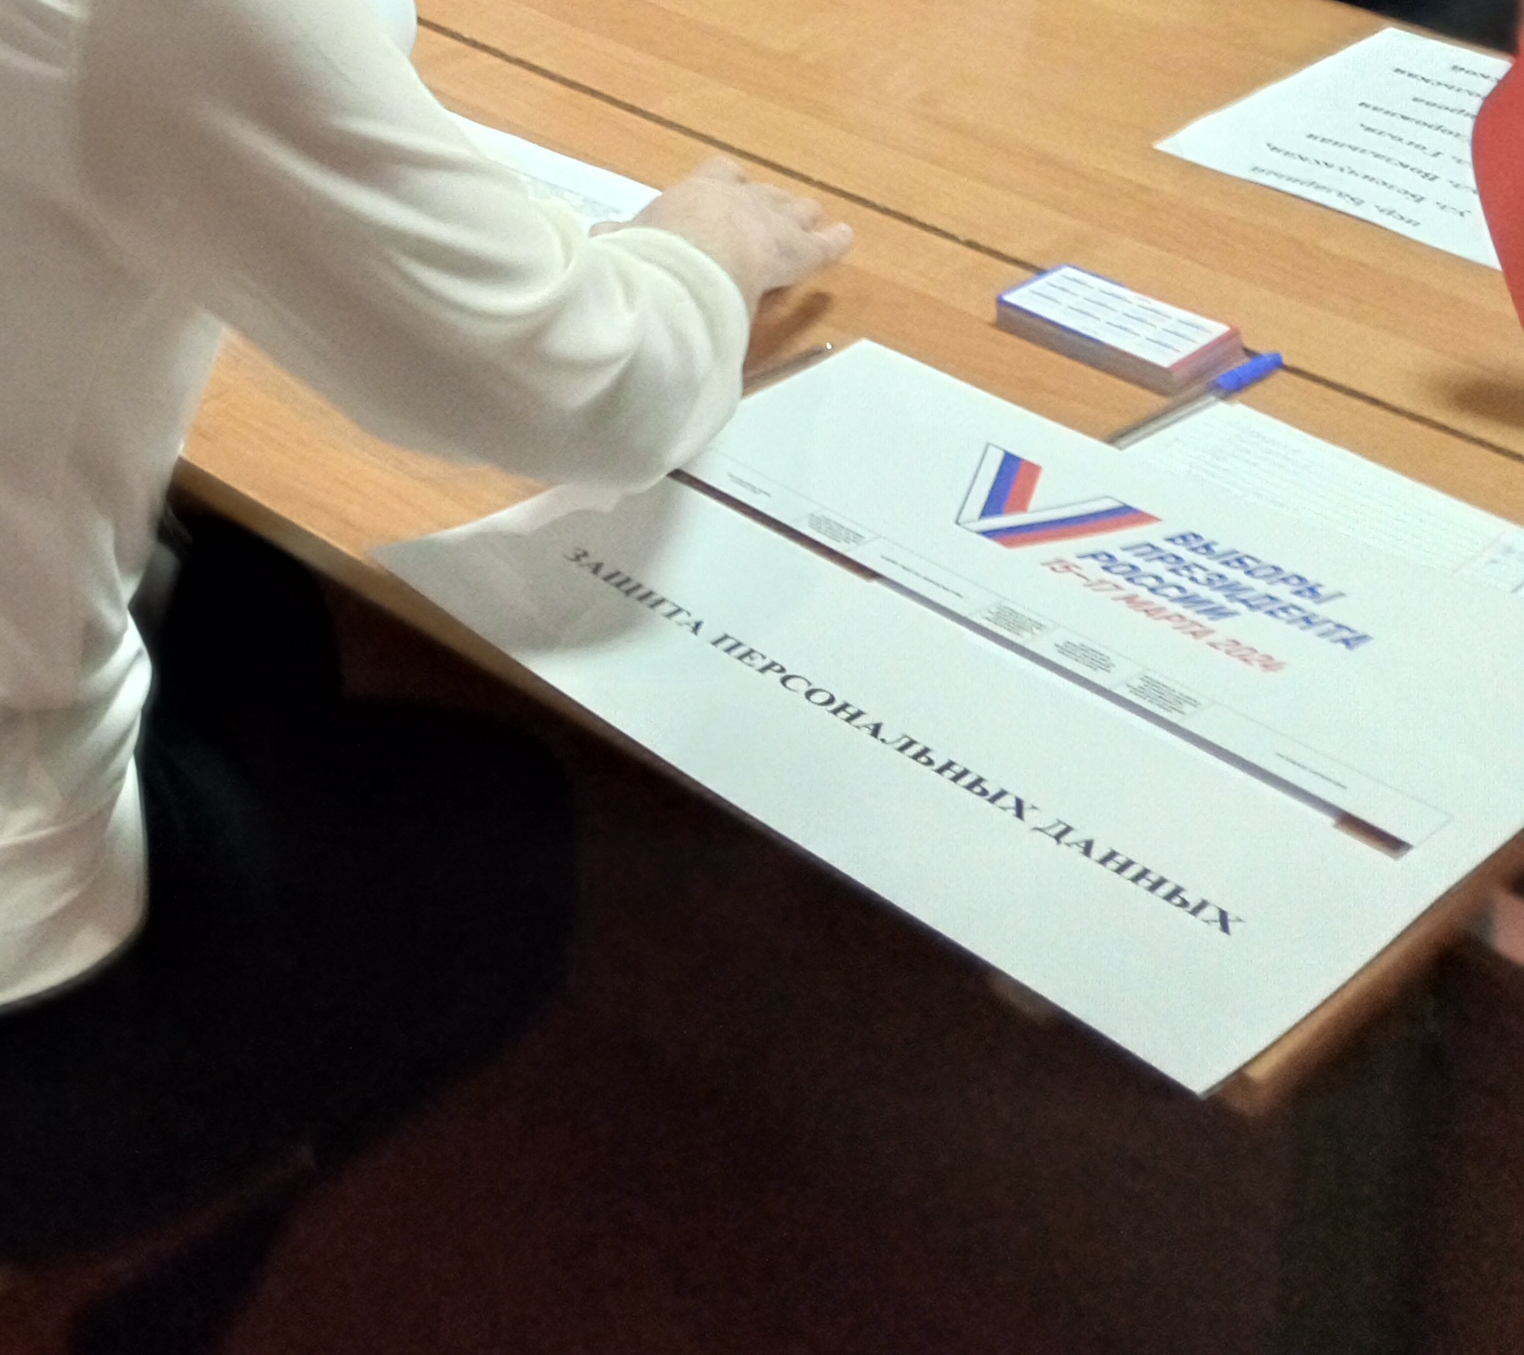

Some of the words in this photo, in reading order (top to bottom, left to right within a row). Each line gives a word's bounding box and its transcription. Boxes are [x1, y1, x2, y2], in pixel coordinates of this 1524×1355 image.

[1076, 550, 1242, 622] РОССИИ
[1119, 541, 1374, 651] ПРЕЗИДЕНТА
[1162, 530, 1347, 605] ВЫБОРЫ
[1111, 593, 1217, 641] МАРТА
[1205, 637, 1289, 673] 2024
[563, 546, 706, 637] ЗАЩИТА
[708, 632, 1040, 823] ПЕРСОНАЛЬНЫХ
[1031, 817, 1247, 937] ДАННЫХ
